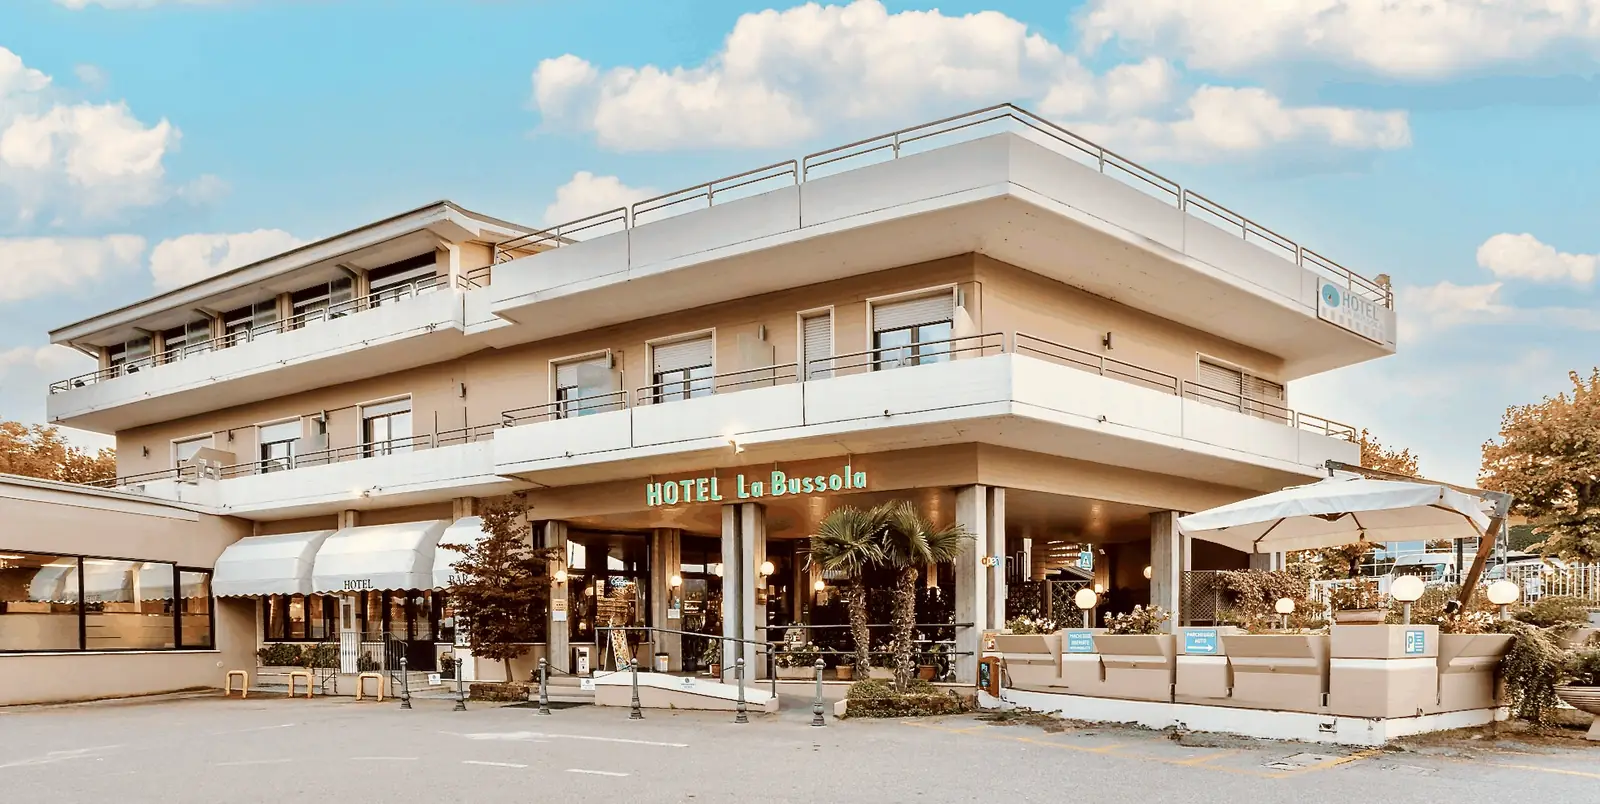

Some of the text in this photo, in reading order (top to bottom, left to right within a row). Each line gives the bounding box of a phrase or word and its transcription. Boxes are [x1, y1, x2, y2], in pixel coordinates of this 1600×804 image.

[1342, 290, 1380, 322] HOTEL
[647, 465, 866, 506] HOTEL La Bussola
[343, 579, 374, 590] HOTEL
